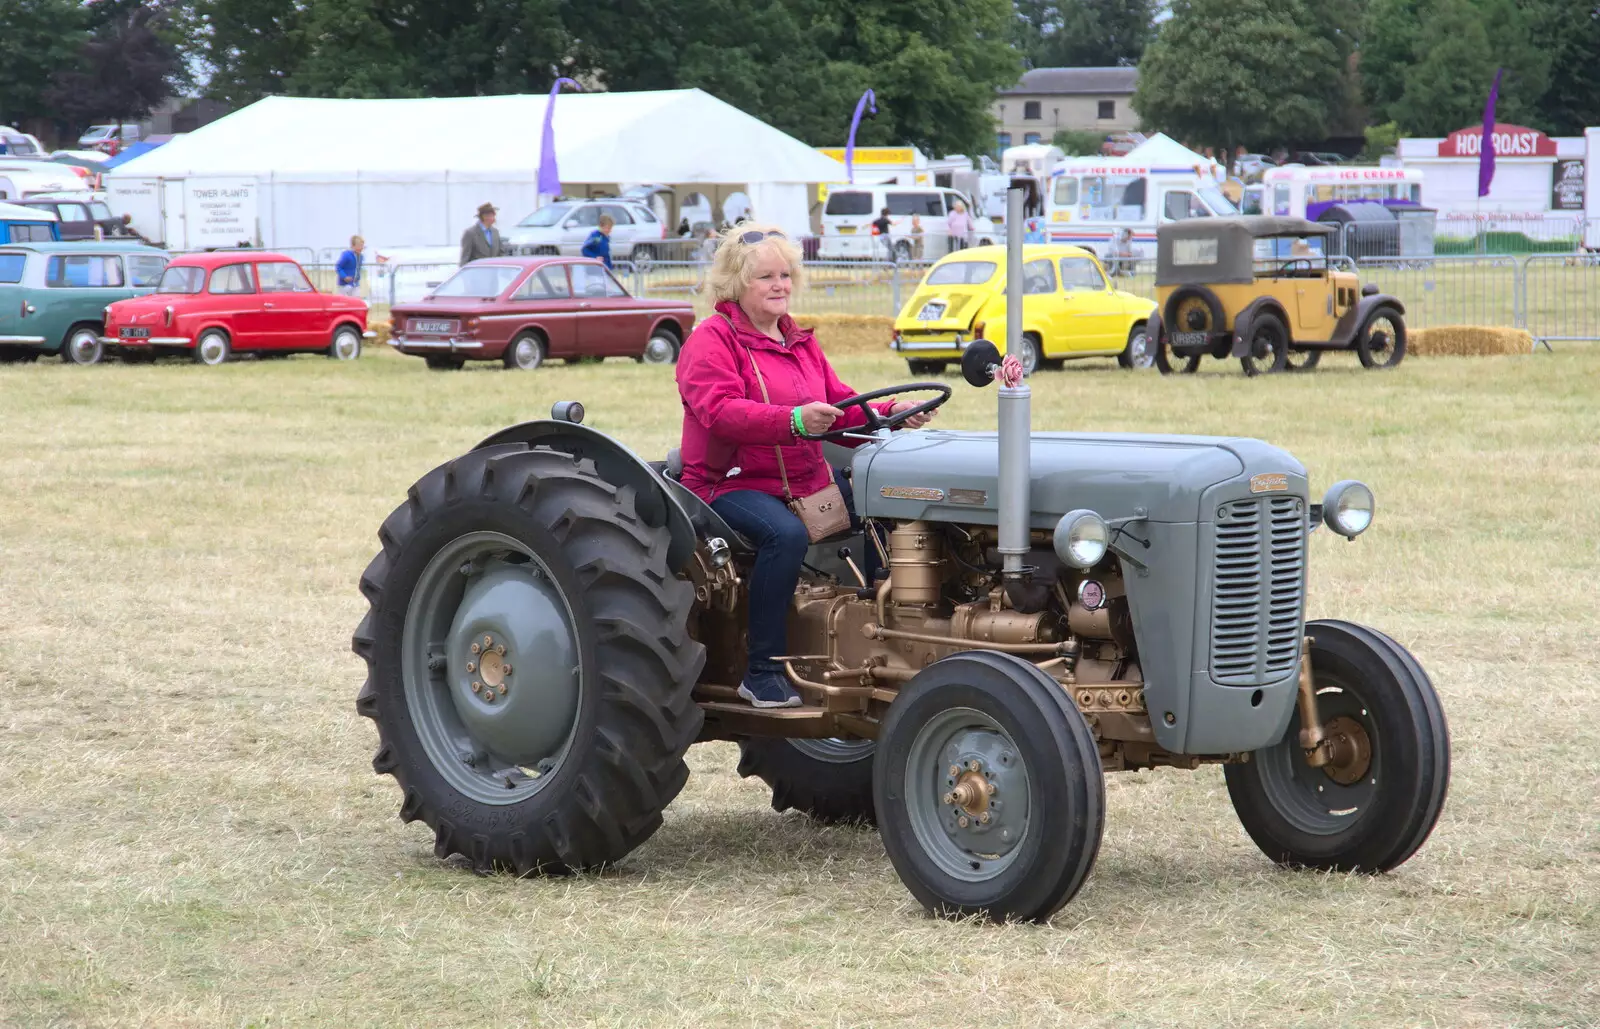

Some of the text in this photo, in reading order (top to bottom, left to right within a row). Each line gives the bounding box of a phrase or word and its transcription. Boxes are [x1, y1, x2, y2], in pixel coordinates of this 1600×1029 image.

[1490, 132, 1539, 154] ROAST
[1340, 171, 1359, 179] ICE
[1364, 170, 1405, 179] CREAM
[192, 189, 249, 198] TOWER PLANTS
